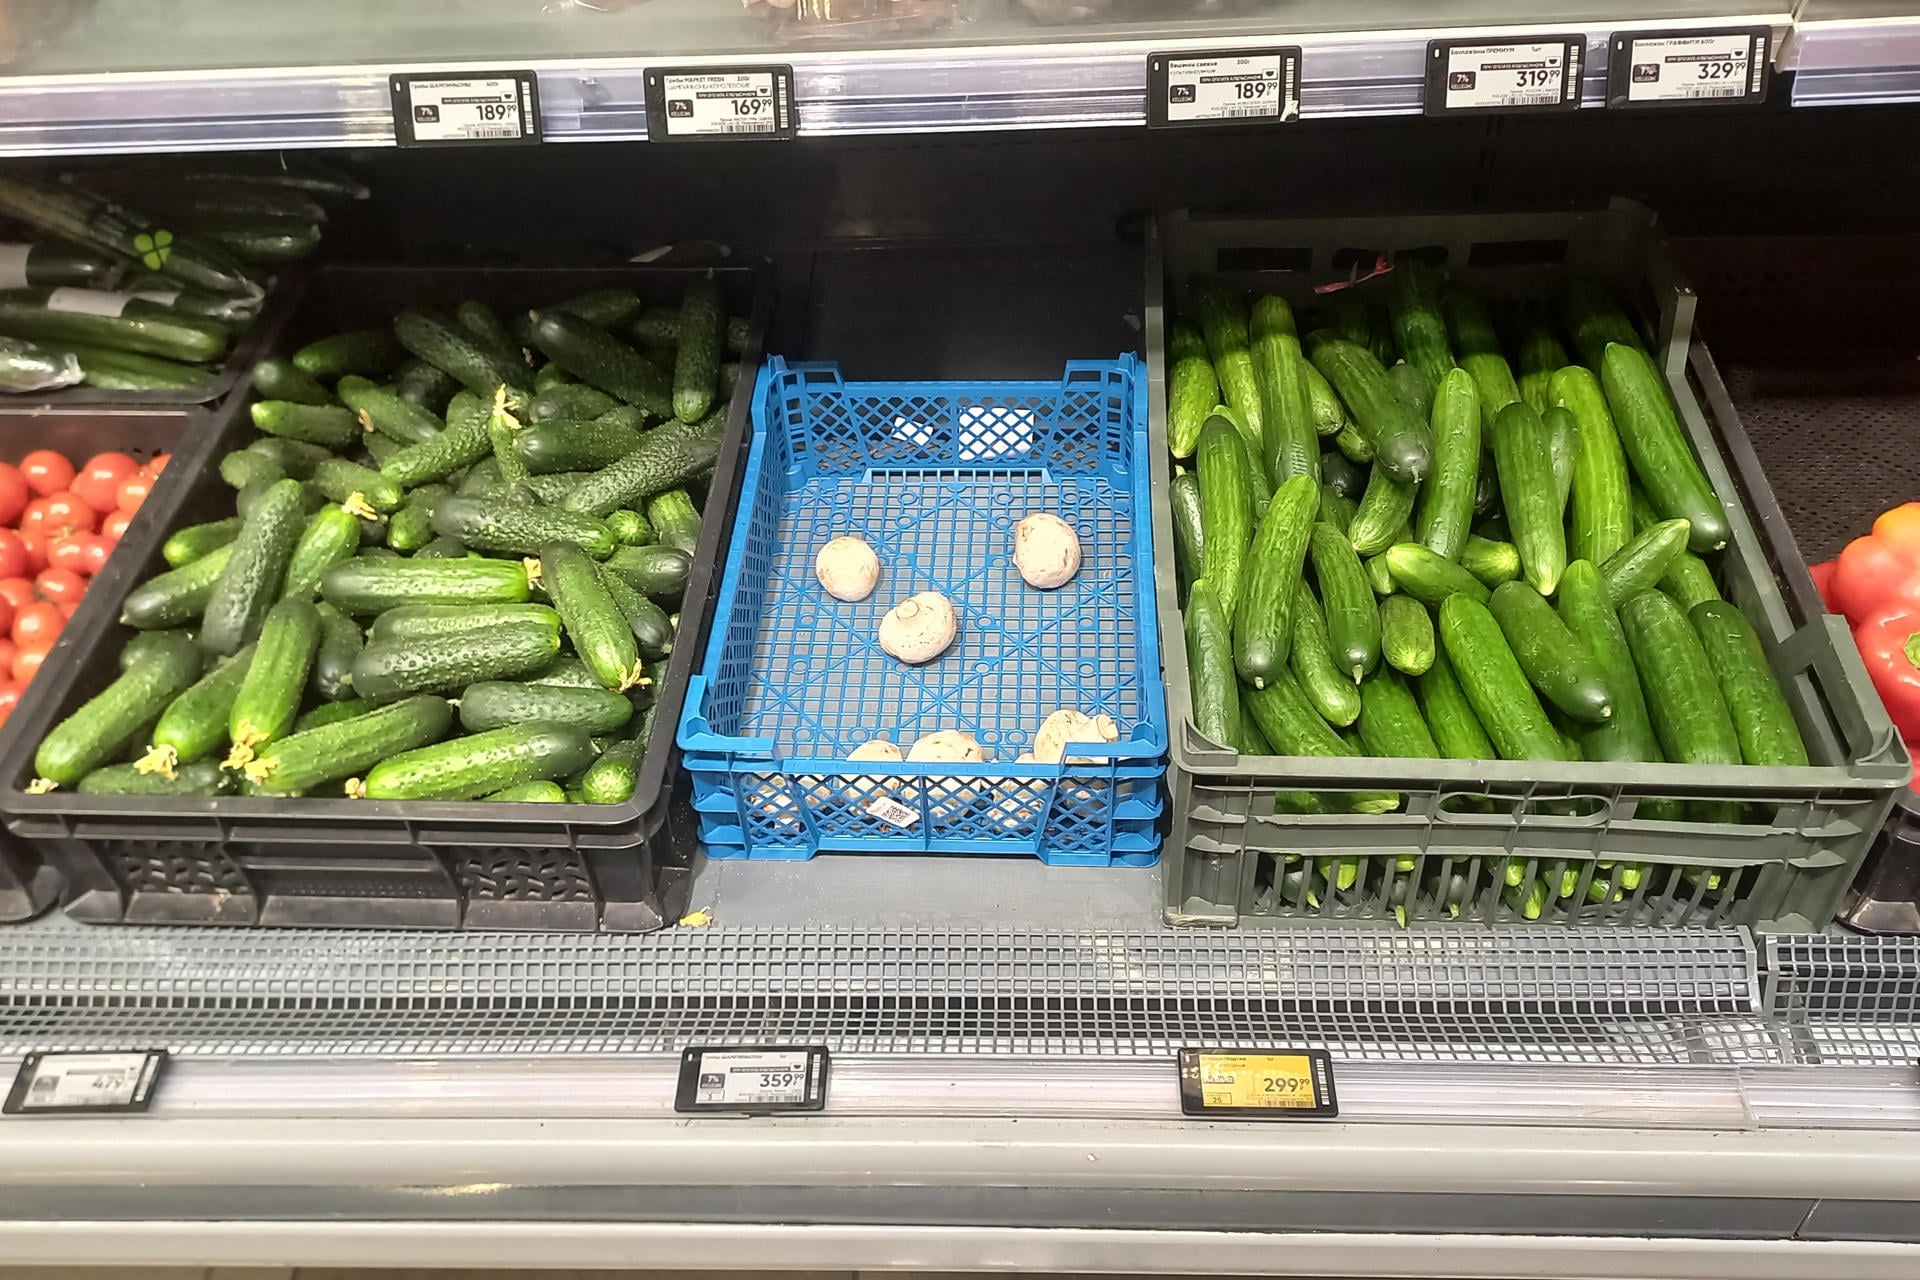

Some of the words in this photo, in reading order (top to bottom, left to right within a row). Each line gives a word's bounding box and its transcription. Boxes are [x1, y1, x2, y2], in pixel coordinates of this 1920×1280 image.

[1456, 74, 1469, 83] 7%
[1640, 66, 1654, 75] 7%
[1697, 62, 1734, 80] 329
[1734, 62, 1747, 70] 99
[1516, 70, 1549, 88] 319
[1549, 70, 1561, 78] 99
[1176, 87, 1190, 96] 7%
[1234, 82, 1266, 100] 189
[1267, 82, 1278, 90] 99
[475, 105, 506, 121] 189
[506, 104, 517, 112] 99
[674, 102, 687, 111] 7%
[731, 99, 762, 115] 169
[762, 99, 773, 107] 99
[759, 1073, 793, 1088] 359
[793, 1073, 805, 1081] 99
[1263, 1077, 1299, 1093] 299
[1299, 1078, 1311, 1086] 99
